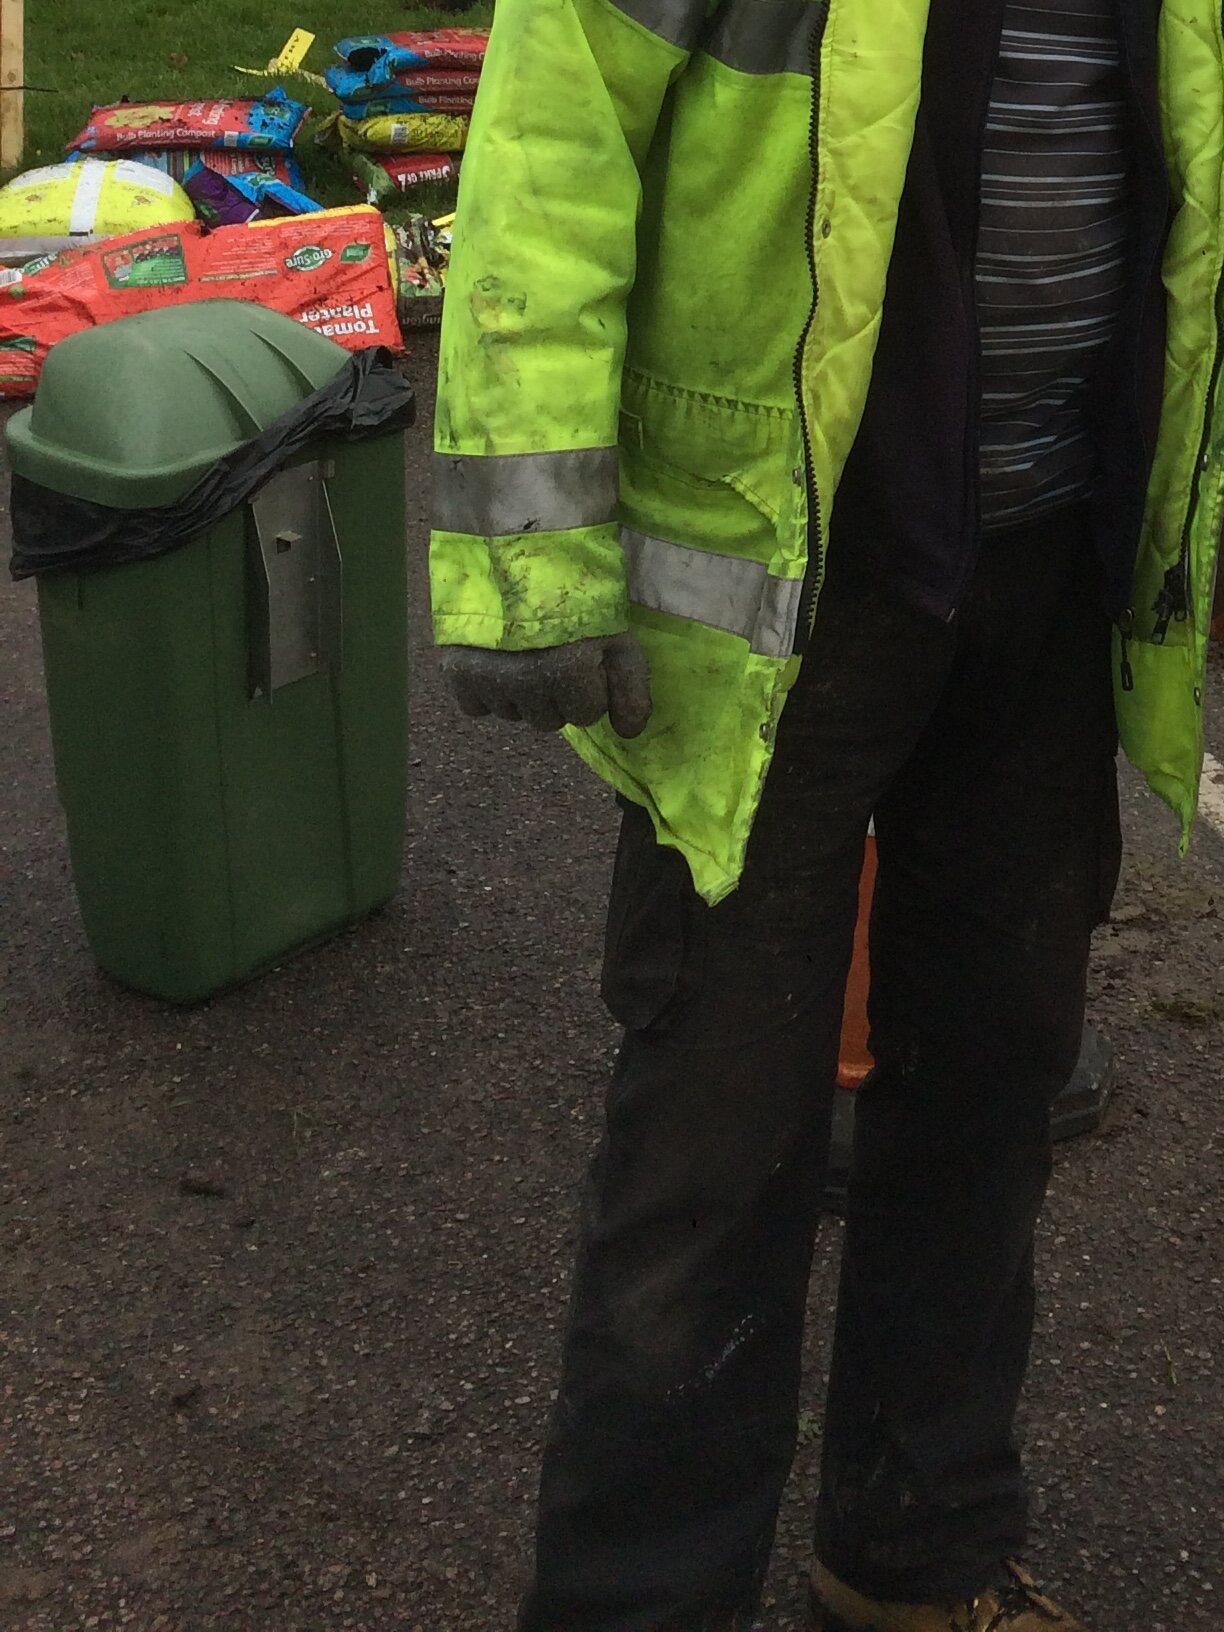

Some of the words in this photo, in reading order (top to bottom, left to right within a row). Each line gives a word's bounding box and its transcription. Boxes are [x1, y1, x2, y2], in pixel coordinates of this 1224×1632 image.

[426, 76, 461, 86] Planting
[116, 131, 136, 141] Bulb
[138, 129, 174, 140] Planting
[176, 127, 216, 138] Compost
[299, 303, 374, 323] Planter
